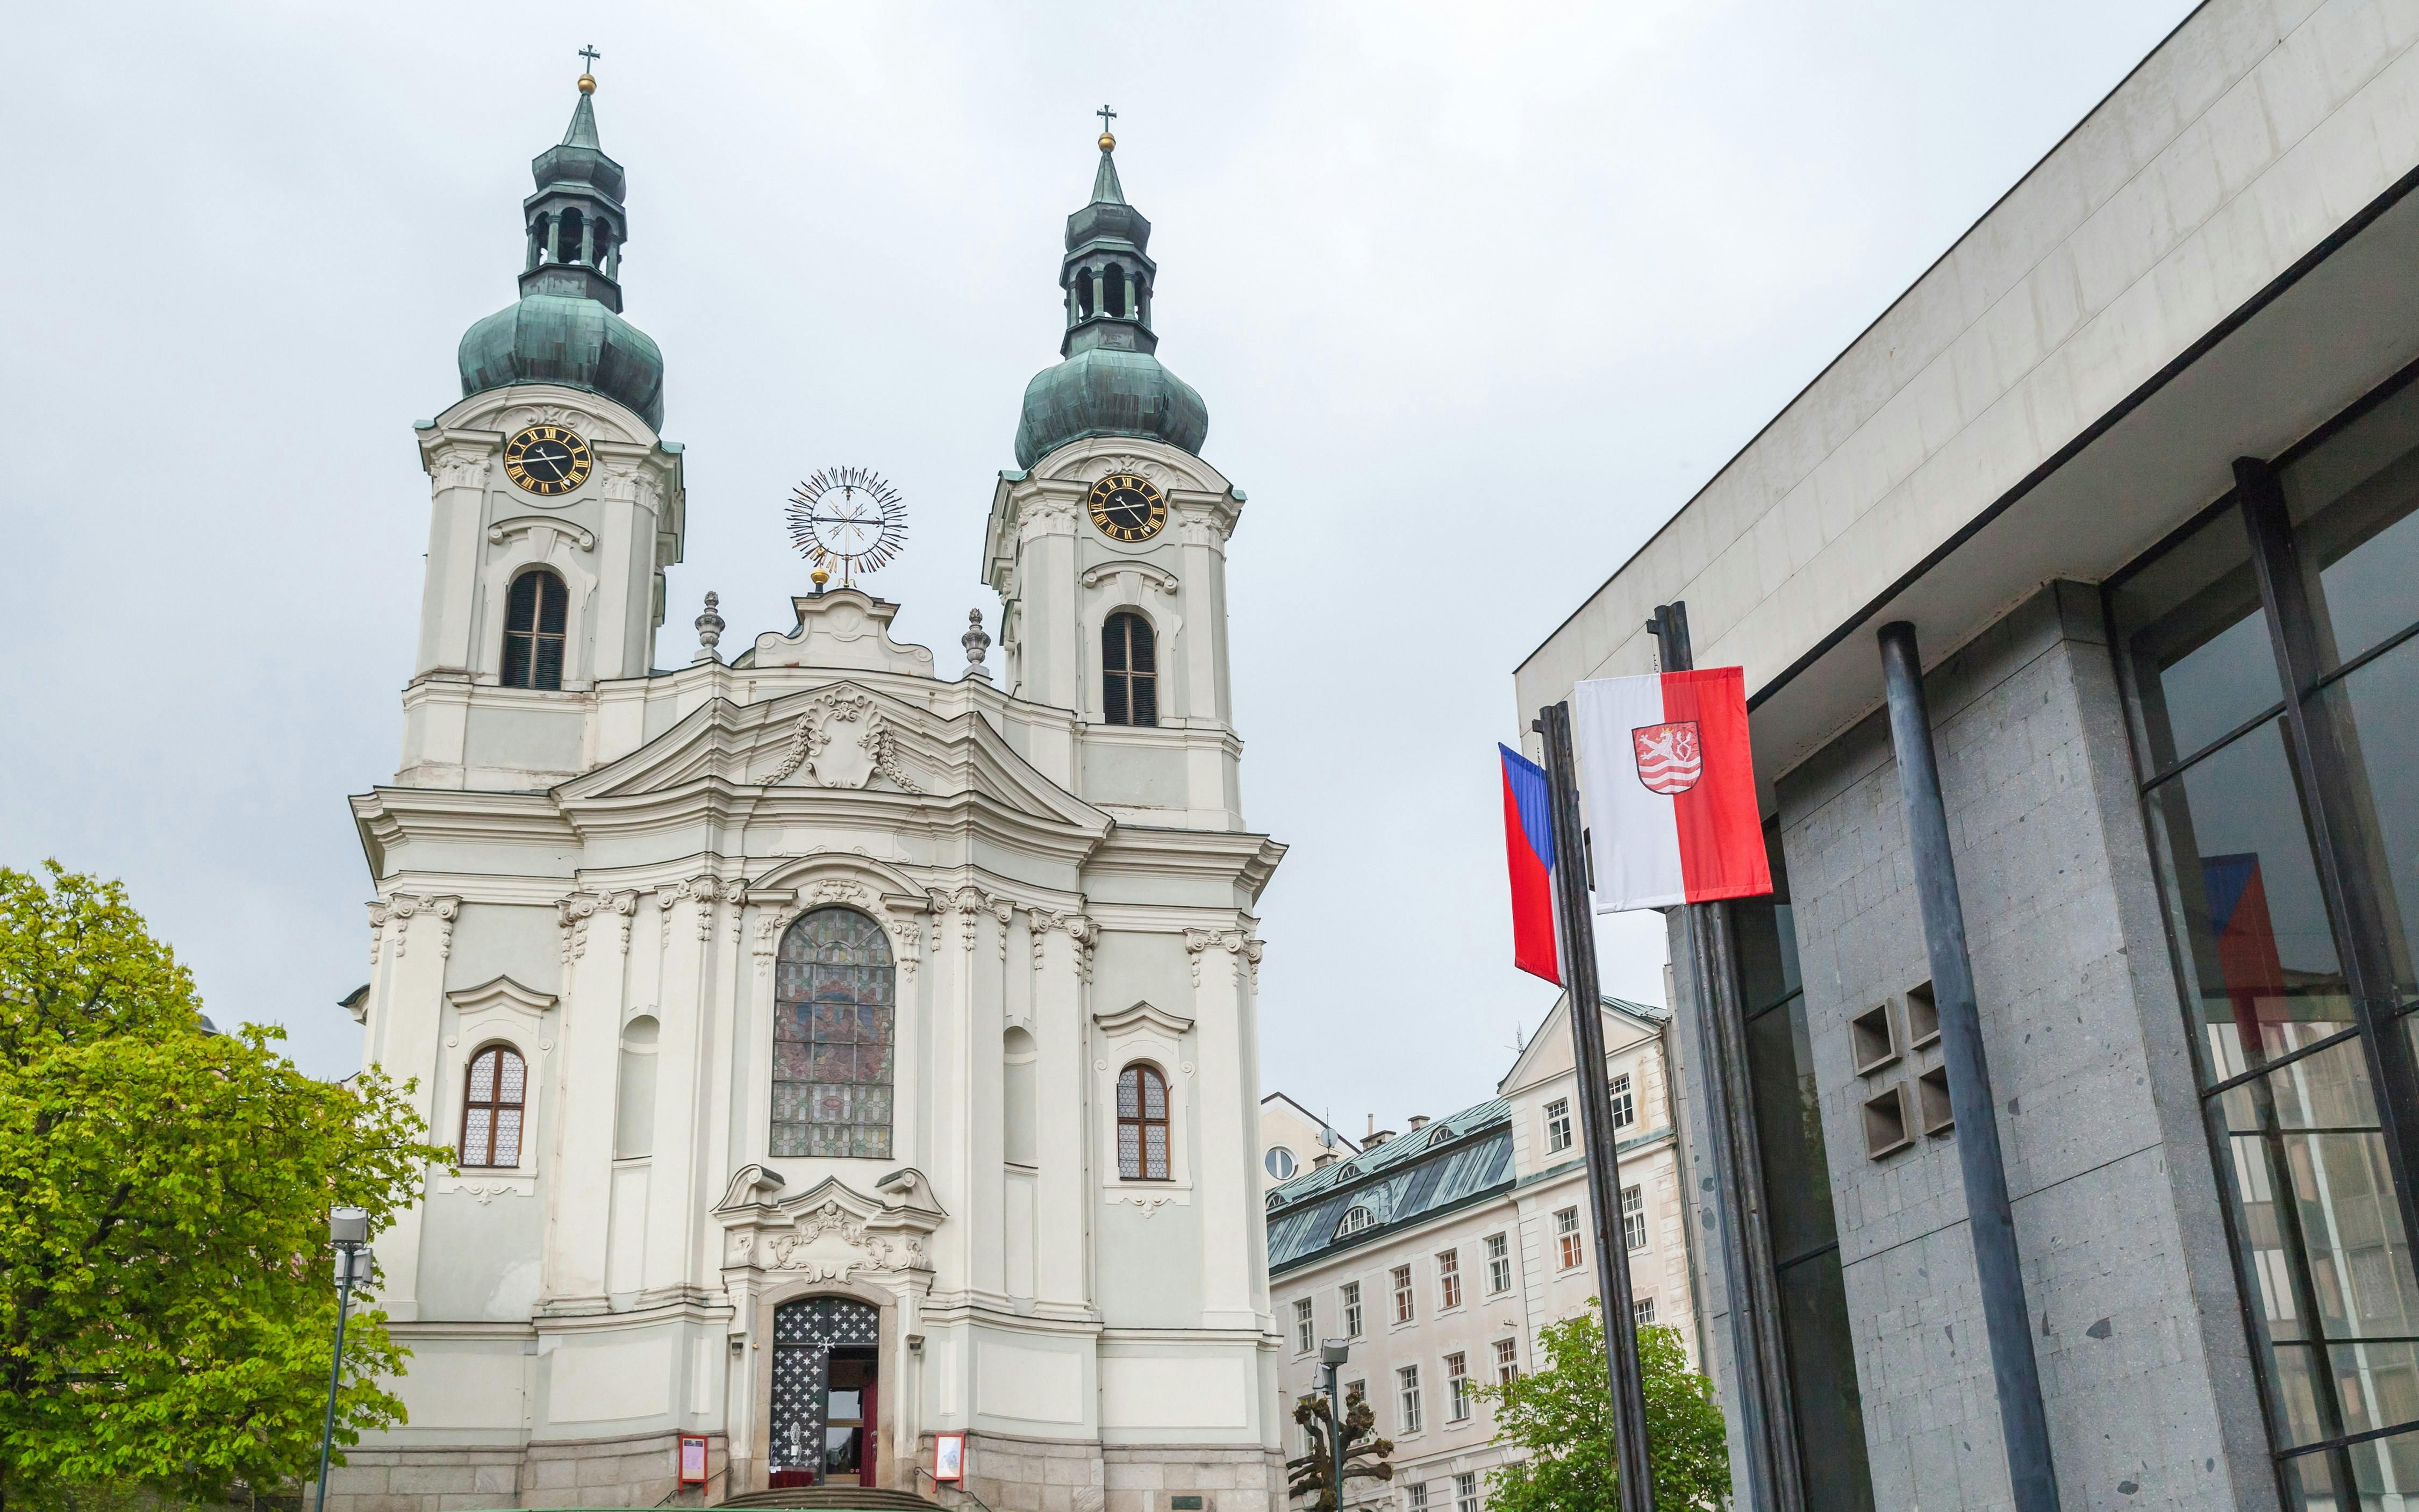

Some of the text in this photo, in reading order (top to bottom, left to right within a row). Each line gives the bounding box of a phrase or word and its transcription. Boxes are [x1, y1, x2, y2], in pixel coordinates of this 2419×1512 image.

[527, 431, 539, 441] XI
[545, 428, 556, 439] XII
[562, 434, 571, 443] I
[514, 440, 526, 449] X
[510, 465, 525, 479] VIII
[570, 471, 584, 483] IIII
[521, 477, 534, 489] VII
[560, 482, 569, 491] V
[1106, 479, 1118, 490] XI
[1122, 477, 1132, 487] XII
[1139, 483, 1146, 491] I
[541, 483, 549, 493] VI
[1095, 490, 1106, 498] X
[1094, 513, 1108, 526] VIII
[1149, 518, 1162, 529] IIII
[1106, 525, 1118, 536] VII
[1124, 530, 1133, 539] VI
[1140, 528, 1149, 537] V
